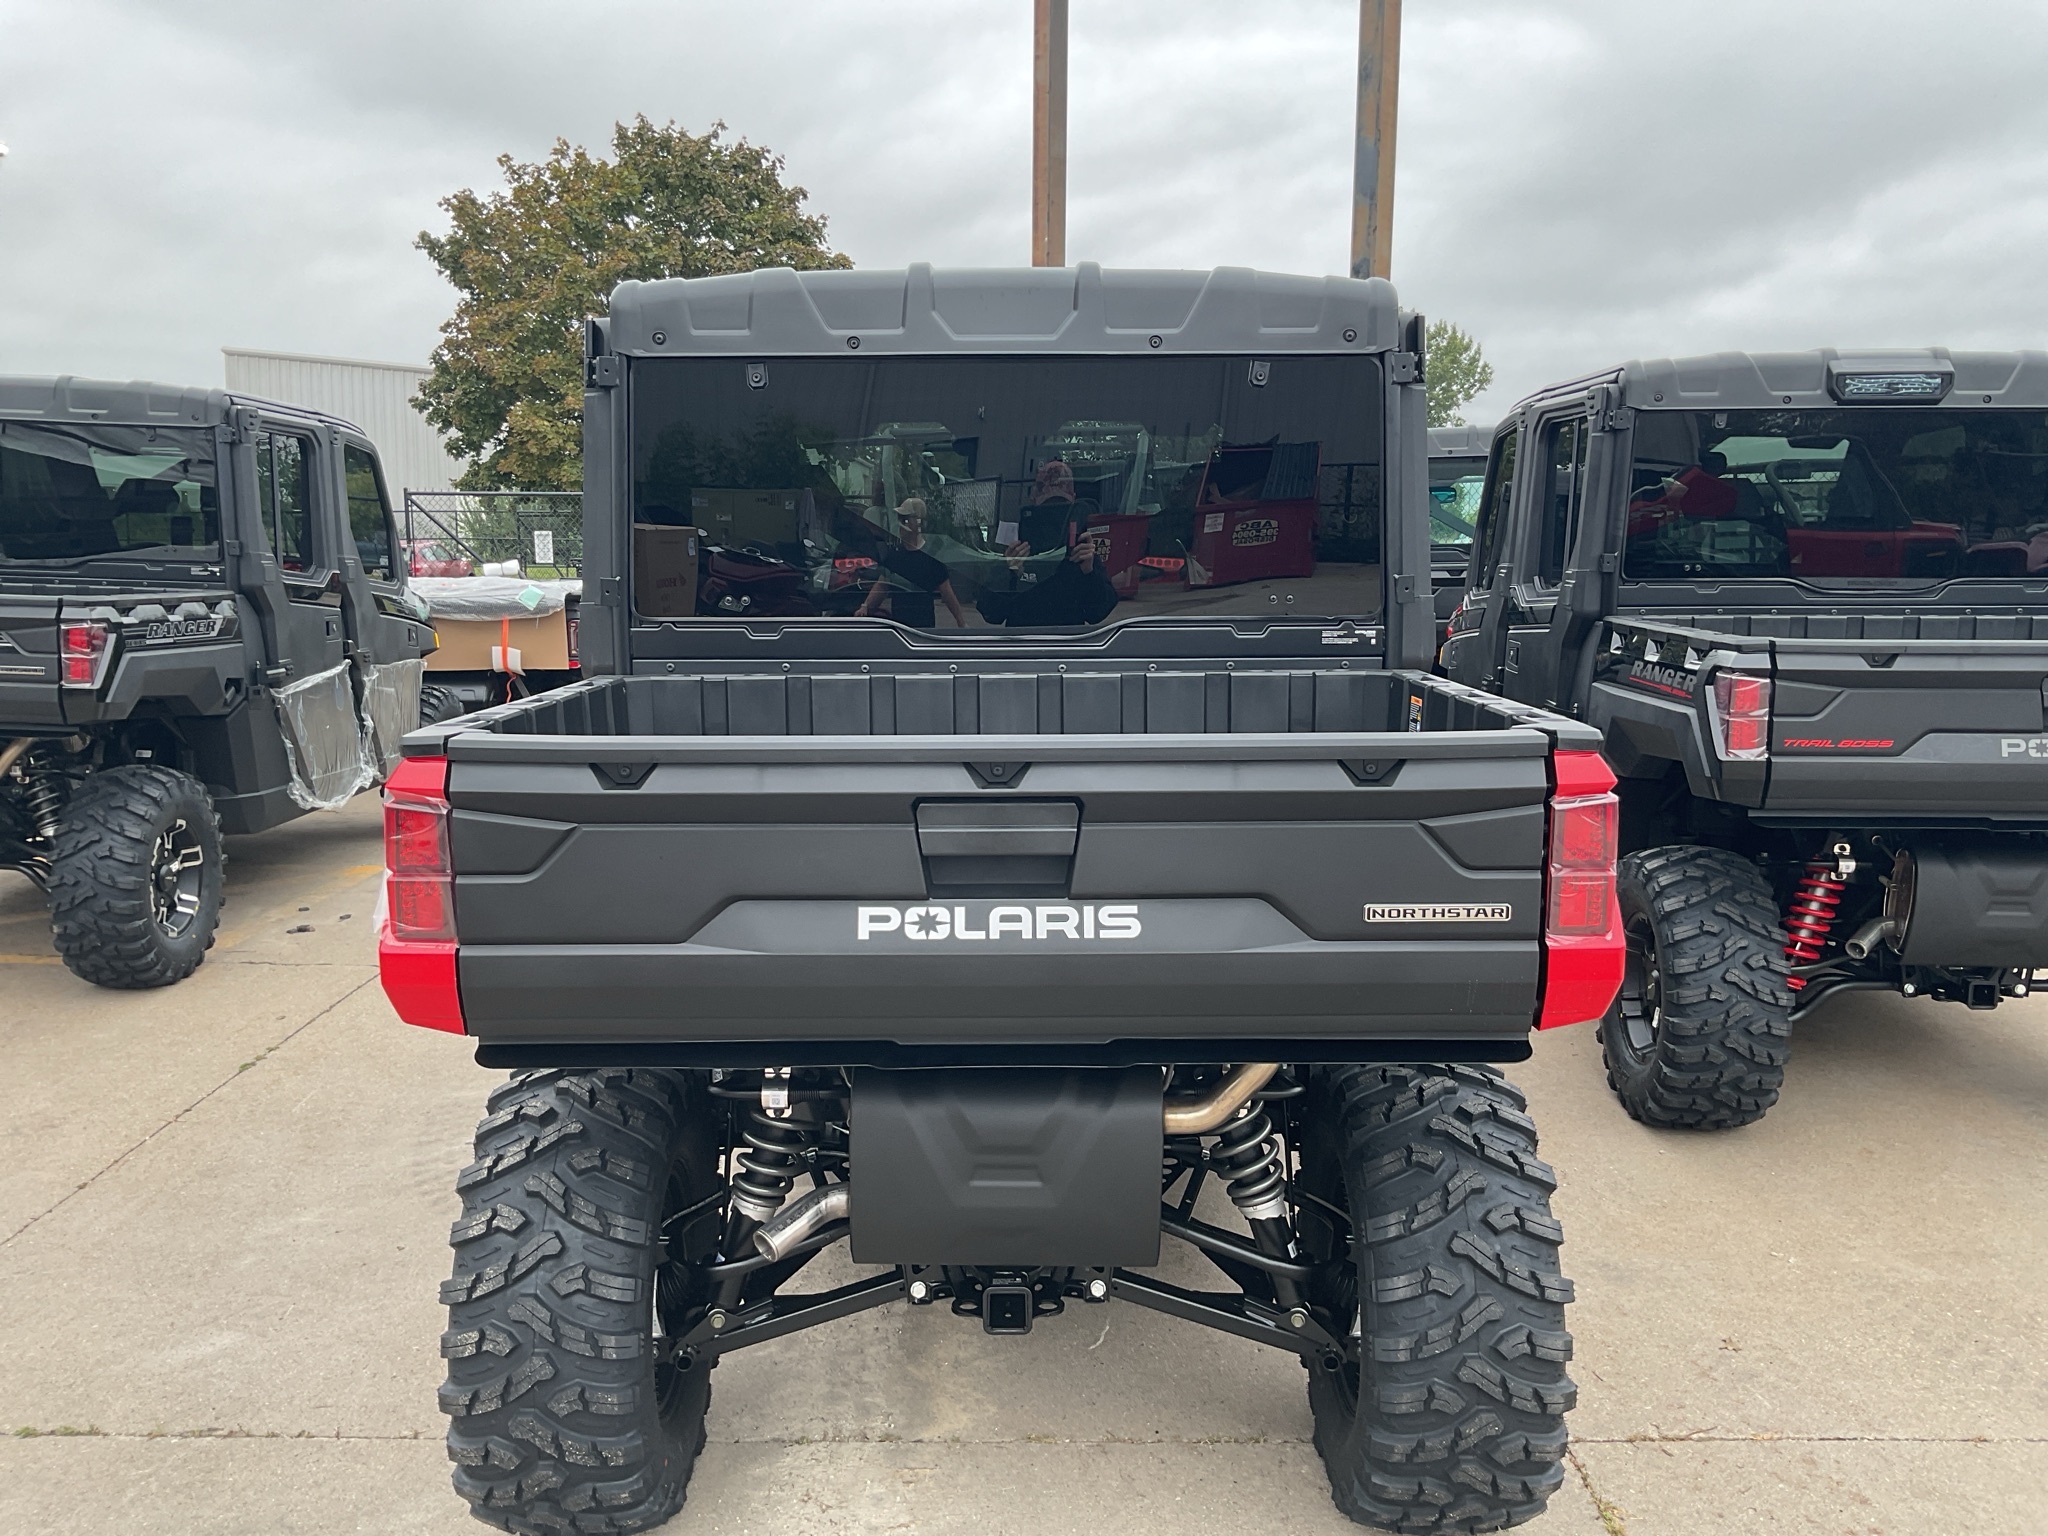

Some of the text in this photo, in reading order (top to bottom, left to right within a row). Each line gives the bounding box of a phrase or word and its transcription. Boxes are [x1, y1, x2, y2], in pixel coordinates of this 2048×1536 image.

[146, 619, 217, 639] RANGER
[1631, 660, 1698, 693] RANGER
[1783, 739, 1894, 748] TRAIL BOSS
[857, 905, 1142, 940] POLARIS
[1371, 907, 1505, 919] NORTHSTAR
